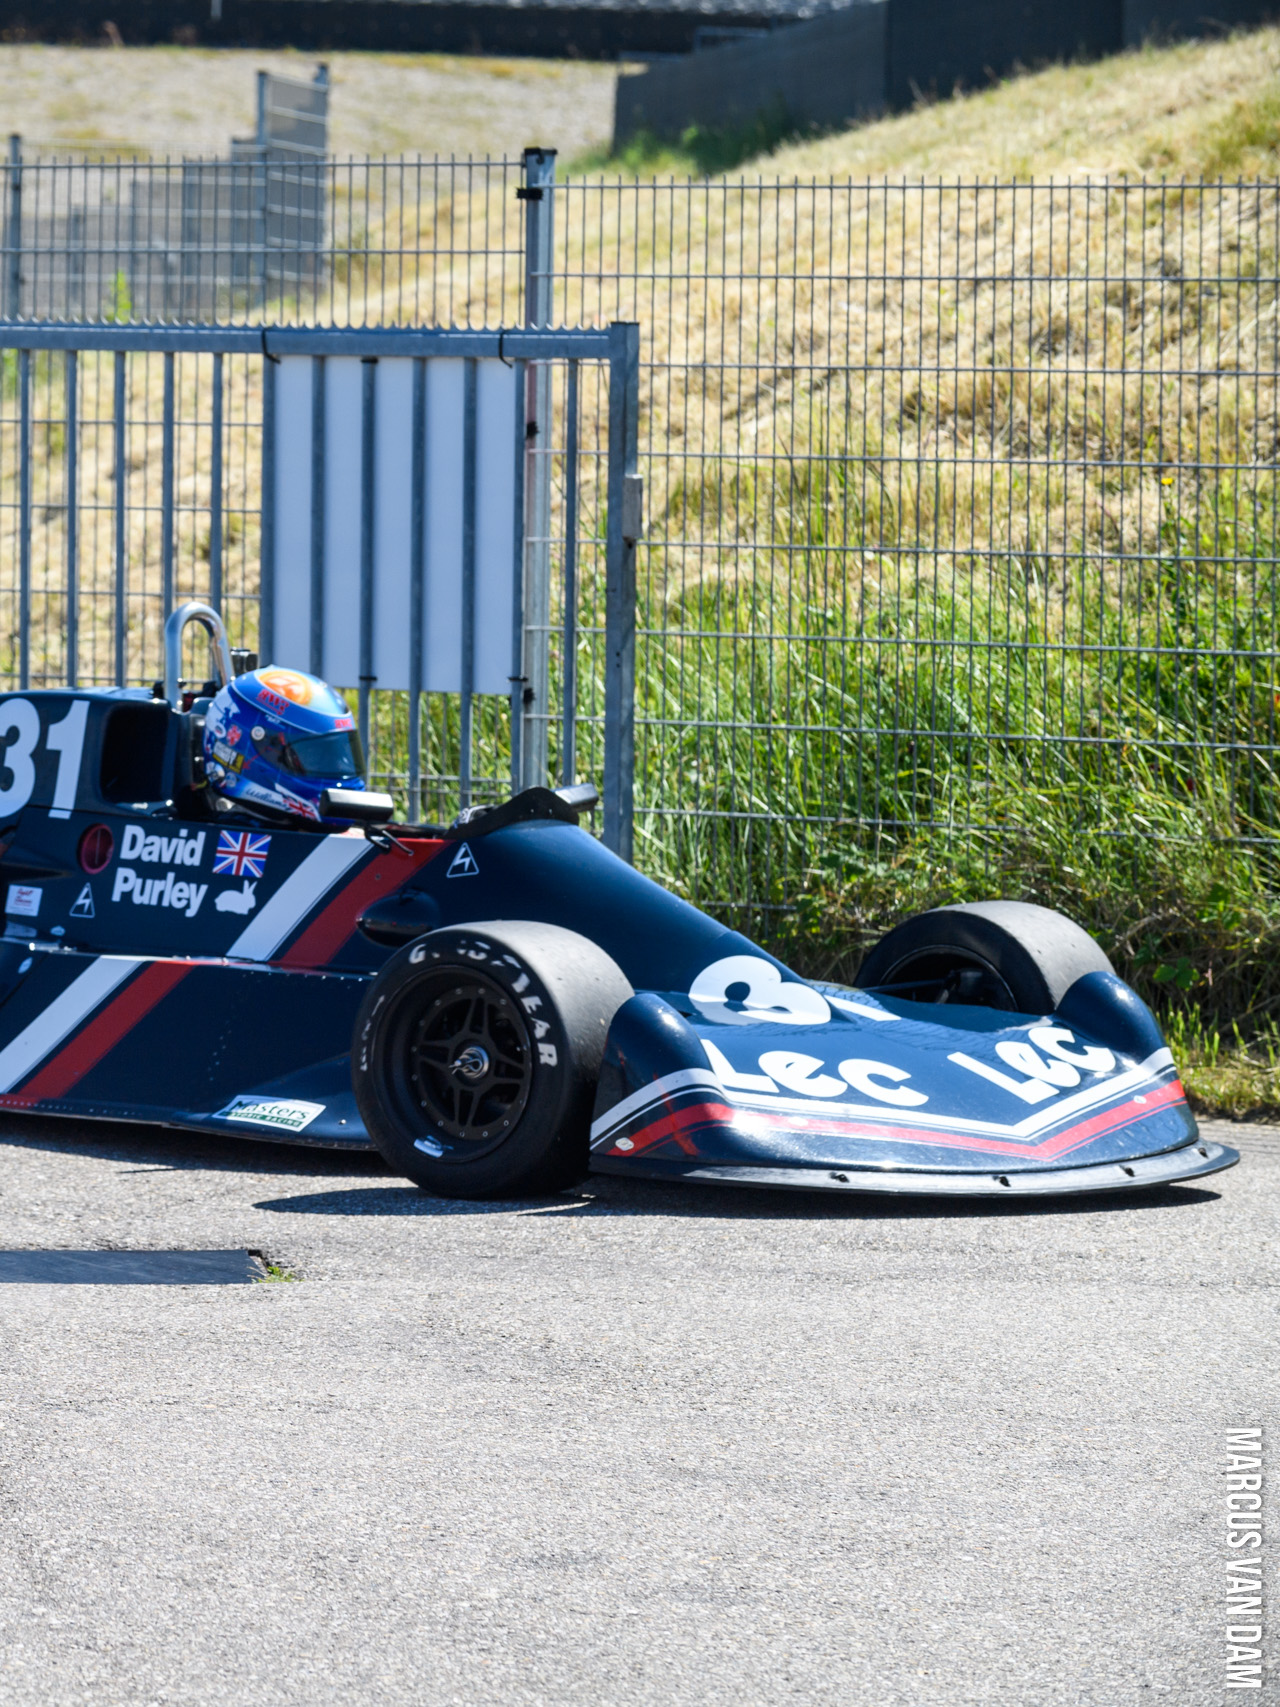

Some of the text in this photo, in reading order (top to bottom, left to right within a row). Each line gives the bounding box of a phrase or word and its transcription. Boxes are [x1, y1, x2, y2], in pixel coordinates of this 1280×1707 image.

[120, 824, 207, 867] David
[112, 867, 209, 918] Purley
[700, 1038, 929, 1107] Lec
[947, 1025, 1117, 1105] Lec
[228, 1100, 310, 1120] Masters
